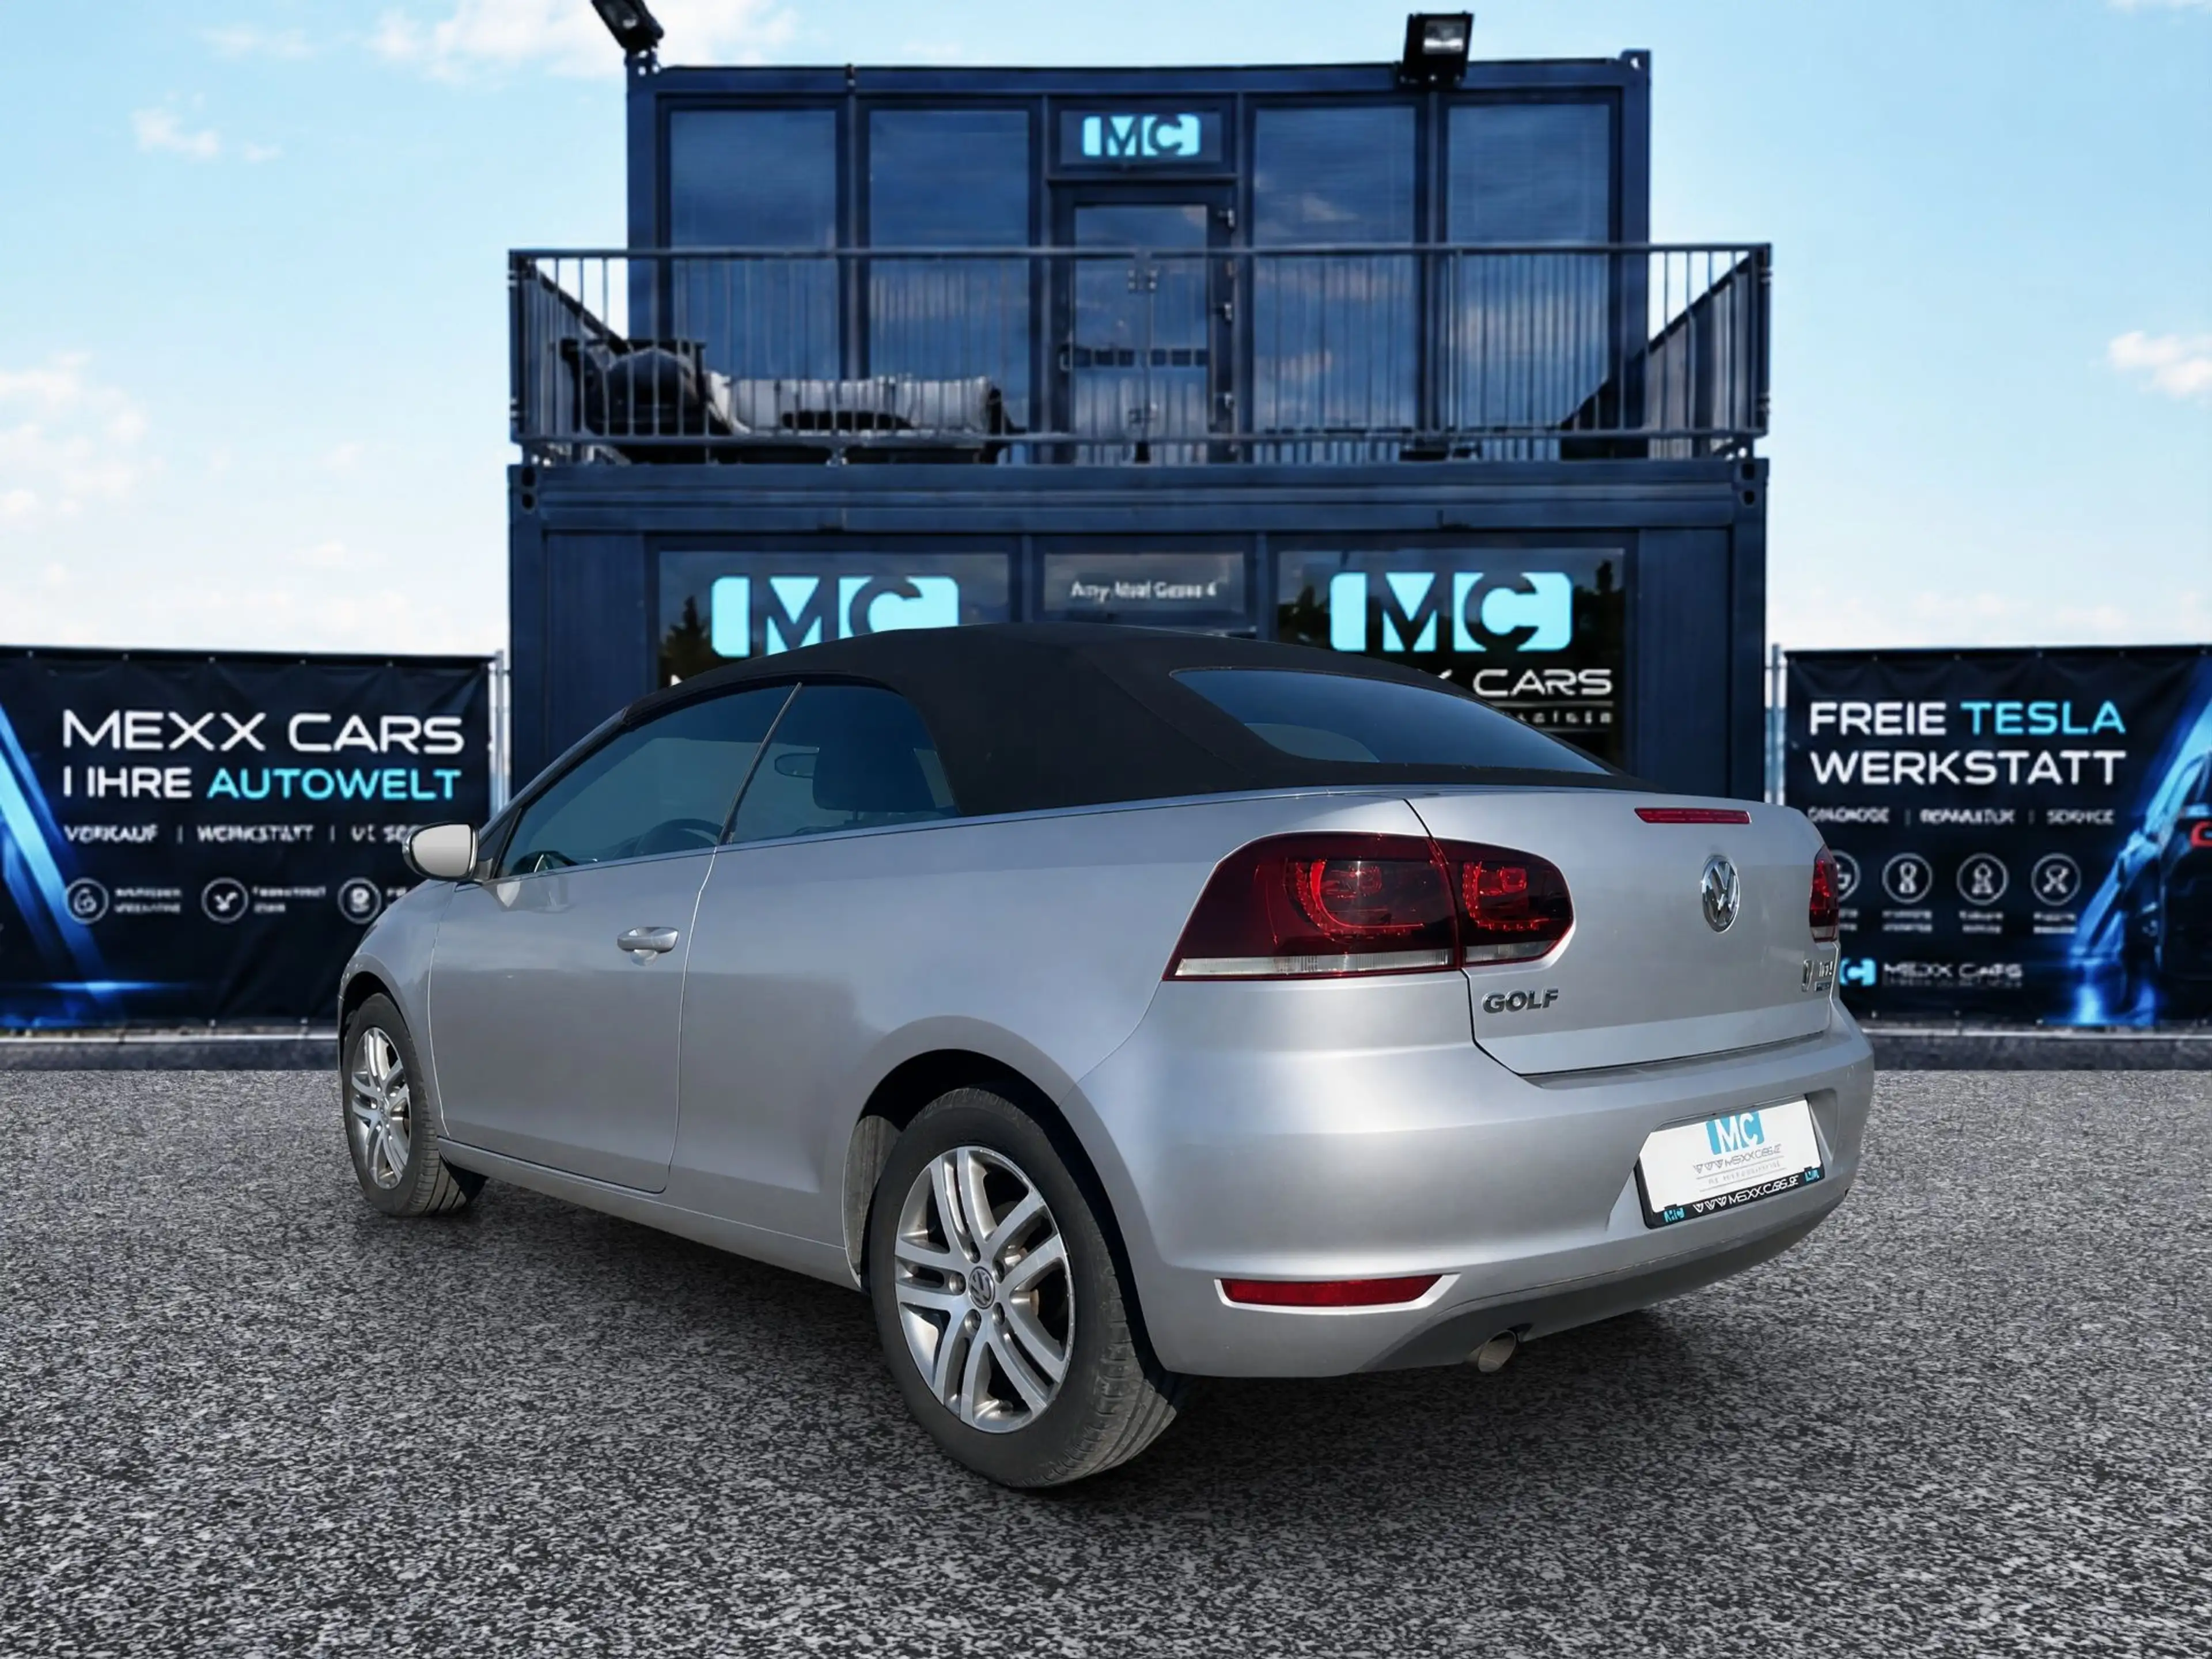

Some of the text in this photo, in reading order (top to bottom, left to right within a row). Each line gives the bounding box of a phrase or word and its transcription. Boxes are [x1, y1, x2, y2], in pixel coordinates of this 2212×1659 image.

[1088, 116, 1196, 156] MC
[1339, 573, 1564, 652] MC
[1473, 669, 1613, 697] CARS
[63, 710, 464, 754] MEXX CARS
[1810, 700, 2126, 735] FREIE TESLA
[87, 767, 192, 798] IHRE
[207, 768, 461, 800] AUTOWELT
[1810, 750, 2127, 785] WERKSTATT
[1482, 987, 1559, 1014] GOLF
[1709, 1109, 1763, 1156] MC
